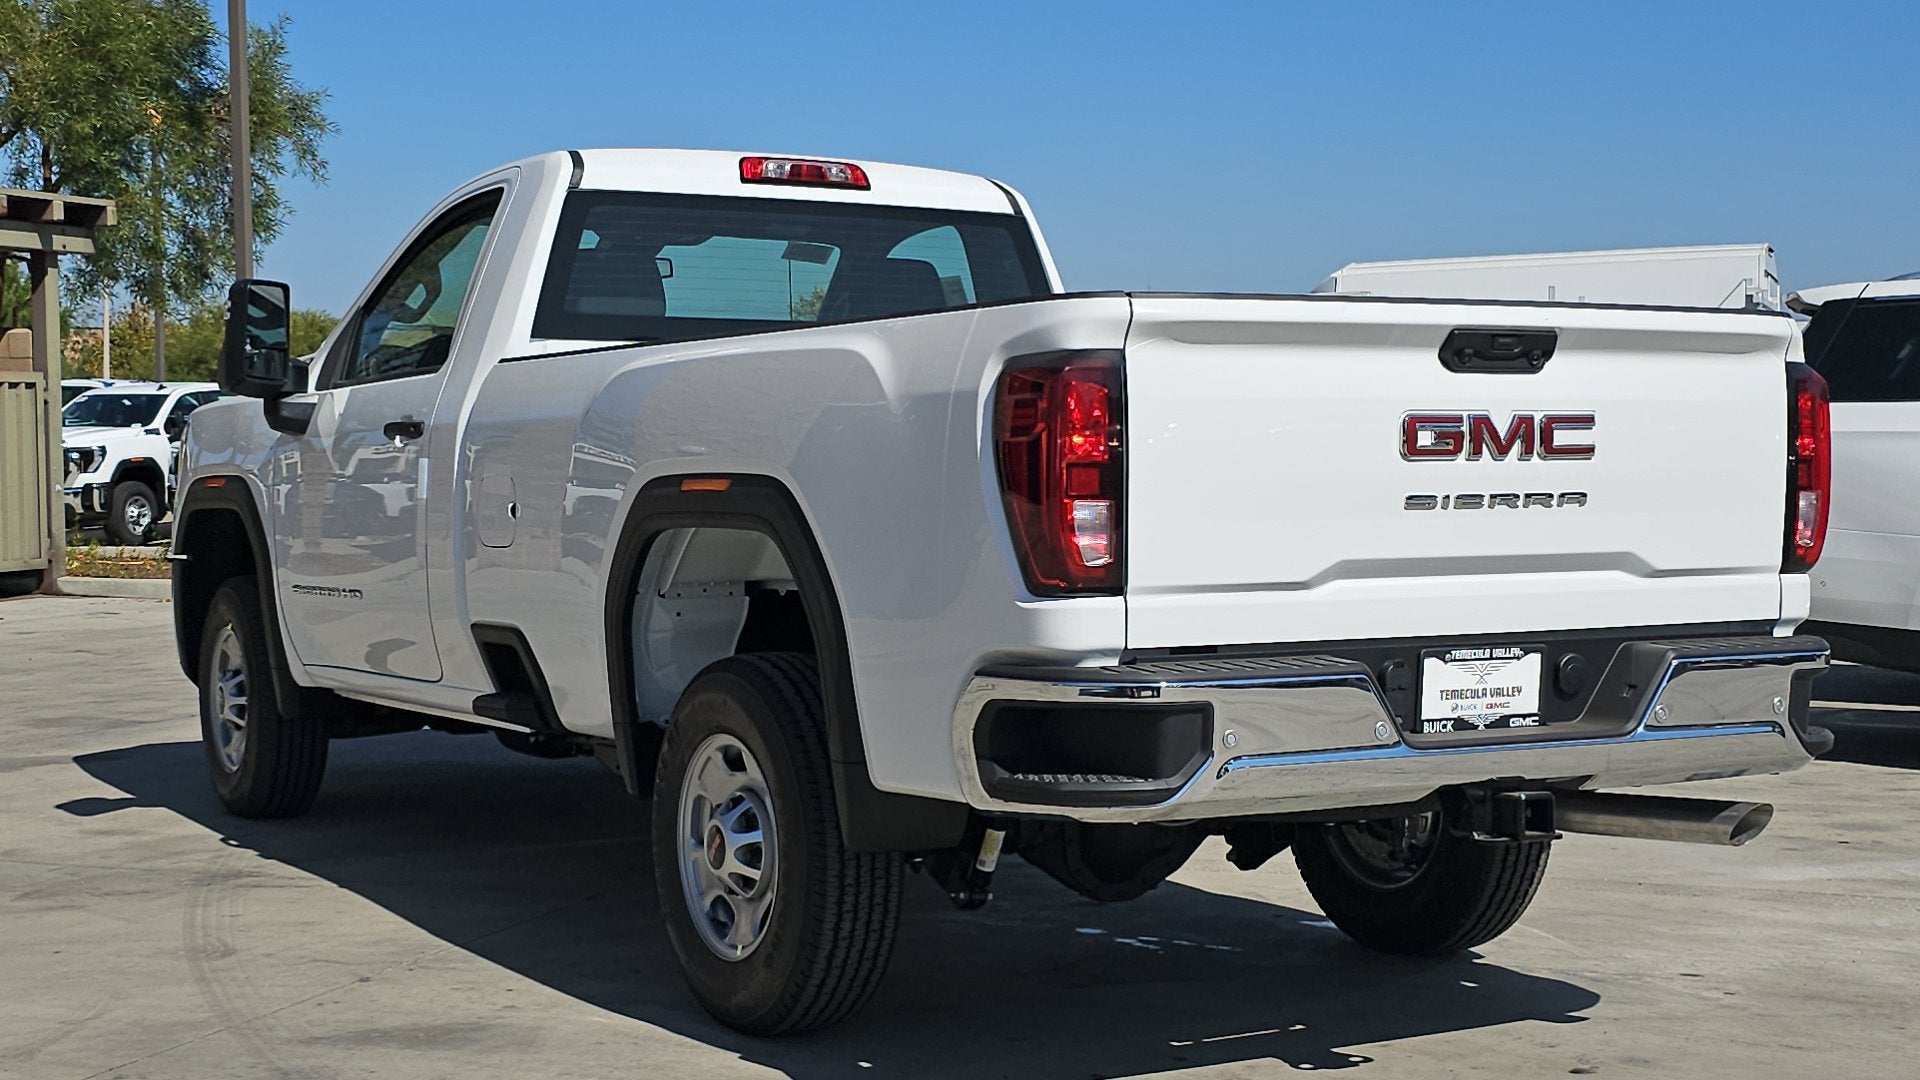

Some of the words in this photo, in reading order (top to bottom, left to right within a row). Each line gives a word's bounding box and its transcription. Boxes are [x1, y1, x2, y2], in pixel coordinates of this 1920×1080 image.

[1399, 409, 1596, 462] GMC
[1404, 492, 1588, 511] SIERRA
[1451, 648, 1491, 660] TEMECULA
[1492, 647, 1520, 658] VALLEY
[1440, 688, 1487, 701] TEMECULA
[1489, 685, 1522, 699] VALLEY
[1460, 703, 1478, 712] BUICK
[1485, 701, 1511, 710] GMC
[1423, 720, 1455, 734] BUICK
[1509, 716, 1540, 727] GMC
